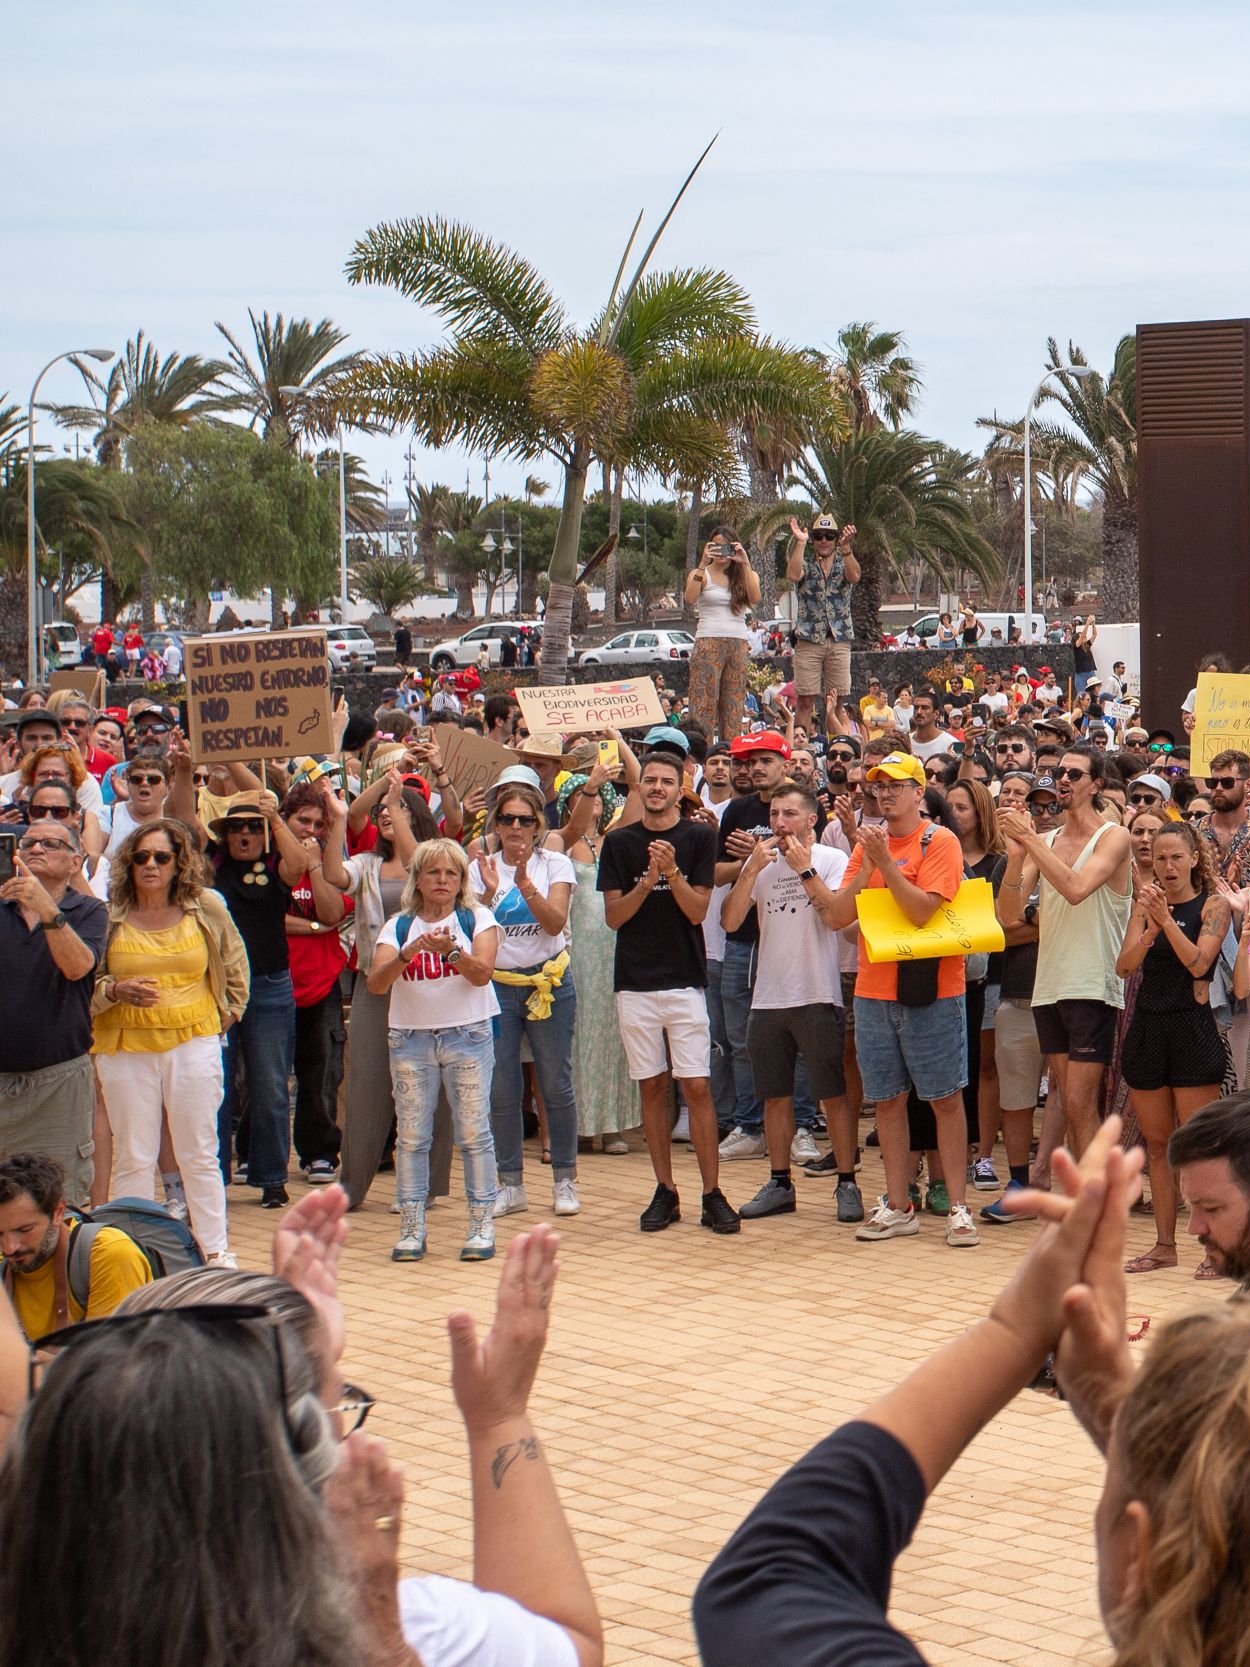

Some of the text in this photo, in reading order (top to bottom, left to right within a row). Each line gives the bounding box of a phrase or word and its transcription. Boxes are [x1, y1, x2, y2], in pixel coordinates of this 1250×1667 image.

[220, 642, 251, 665] NO
[254, 637, 325, 663] RESPETAN
[191, 665, 329, 695] NUESTRO ENTORNO,
[521, 688, 577, 700] NUESTRA
[543, 694, 639, 710] BIODIVERSIDAD
[199, 695, 290, 724] NO NOS
[546, 703, 649, 726] SE ACABA
[1232, 719, 1241, 730] es
[202, 725, 290, 753] RESPETAN.
[1206, 737, 1235, 756] STOP
[504, 924, 542, 938] ALVAR
